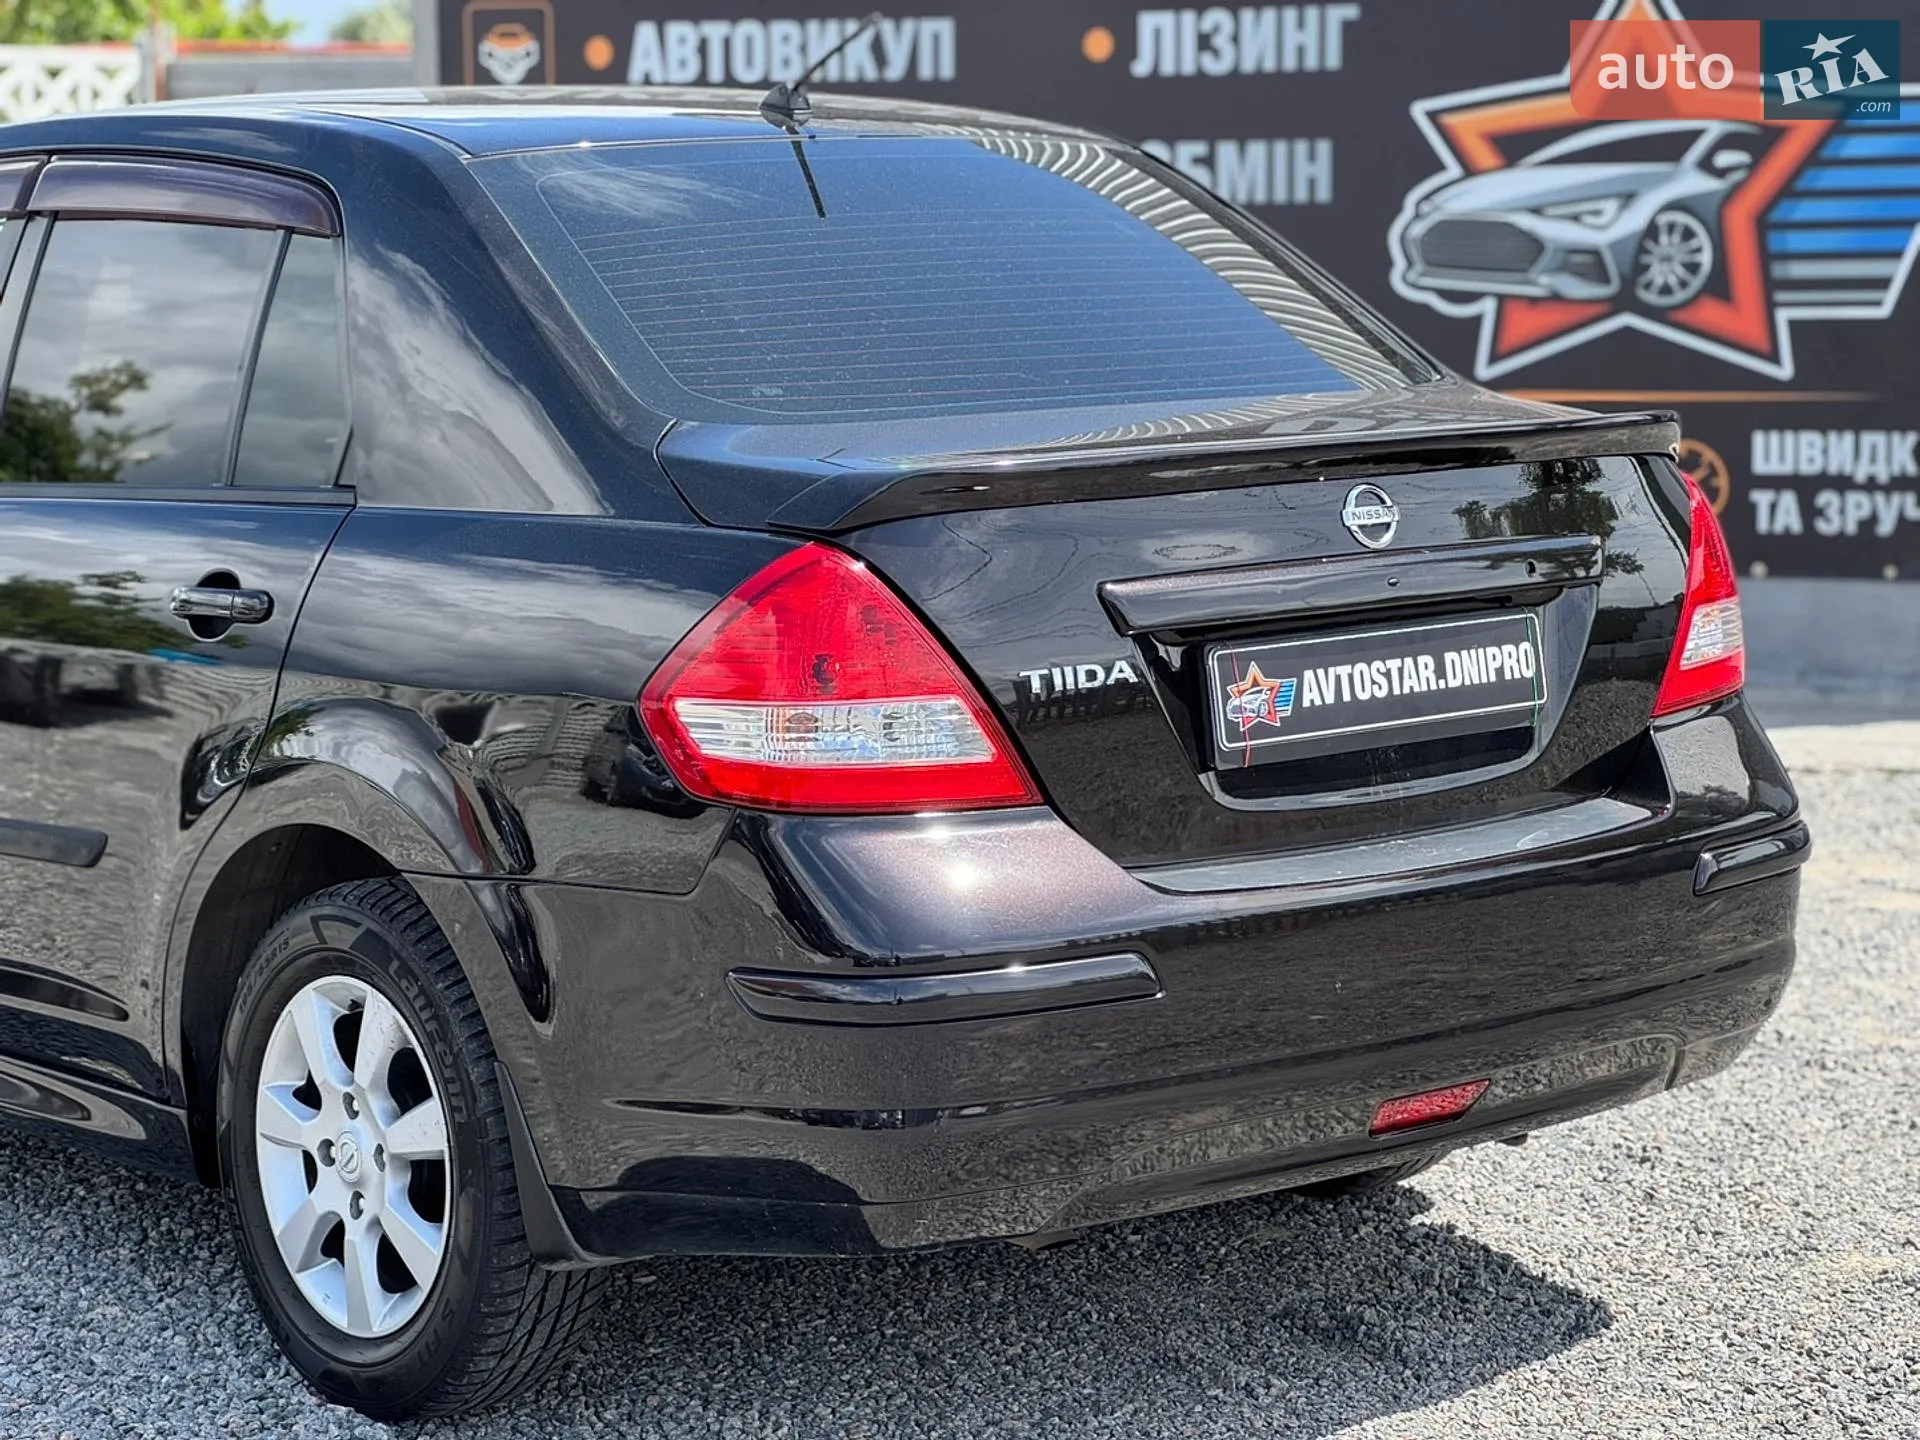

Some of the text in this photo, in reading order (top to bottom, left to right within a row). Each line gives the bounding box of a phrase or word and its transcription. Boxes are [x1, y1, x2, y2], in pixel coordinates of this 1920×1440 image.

[626, 16, 956, 84] АВТОВИКУП
[1129, 4, 1361, 78] ЛІЗИНГ
[1751, 429, 1920, 485] ШВИДК
[1748, 487, 1804, 536] ТА
[1018, 659, 1139, 694] TIIDA
[1301, 641, 1536, 708] AVTOSTAR.DNIPRO
